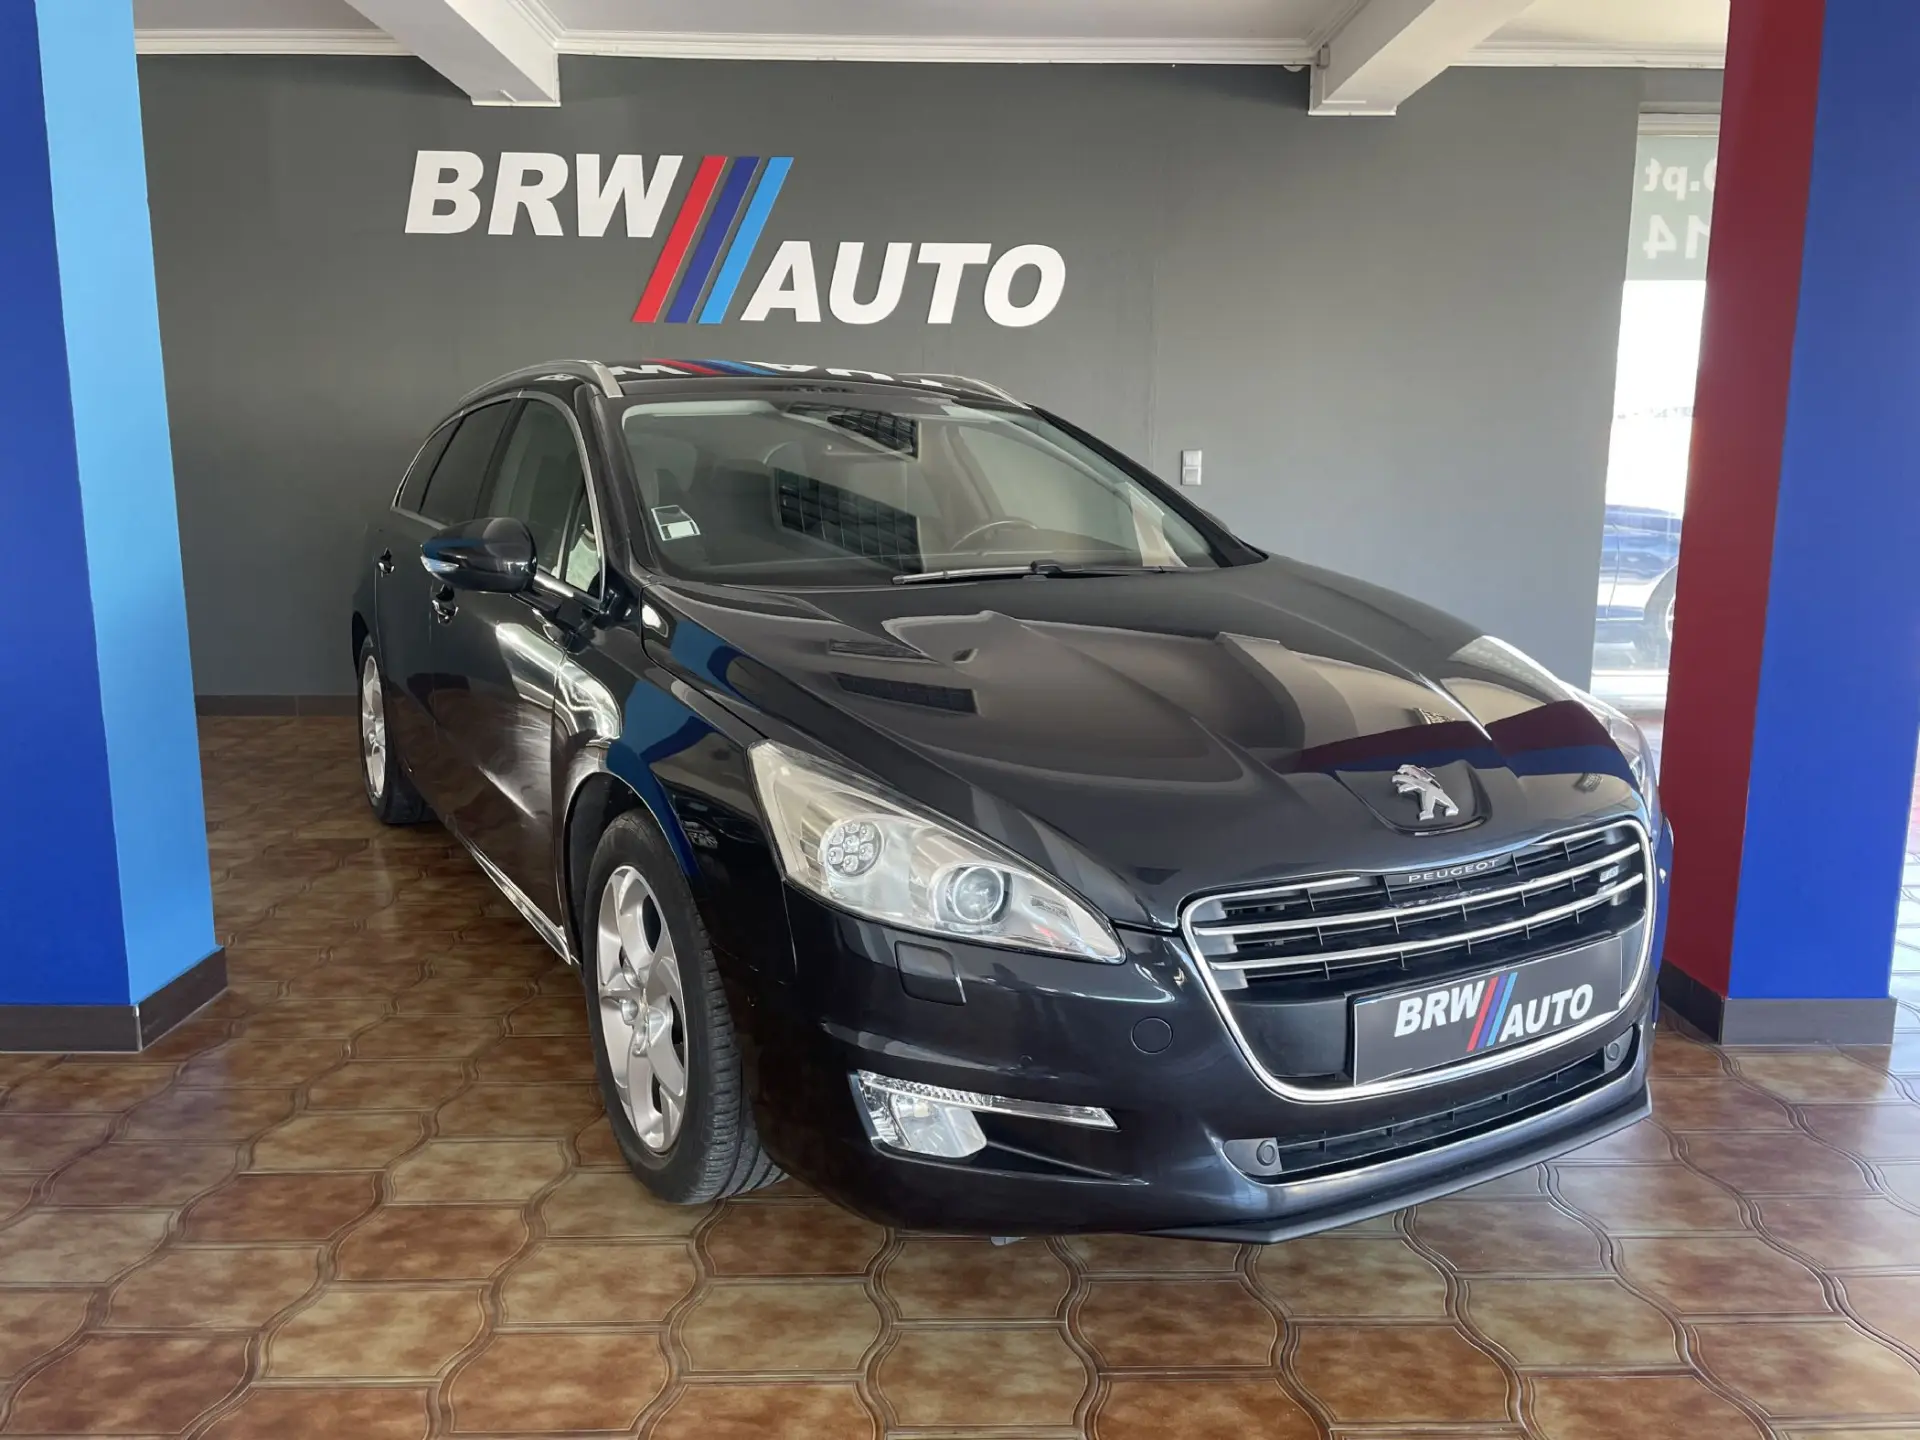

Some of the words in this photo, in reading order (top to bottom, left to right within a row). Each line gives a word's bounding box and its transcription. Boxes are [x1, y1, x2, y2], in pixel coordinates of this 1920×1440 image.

[405, 150, 684, 238] BRW
[740, 241, 1066, 328] AUTO
[1408, 858, 1500, 883] PEUGEOT
[1394, 980, 1485, 1038] BRW
[1499, 984, 1594, 1043] AUTO
